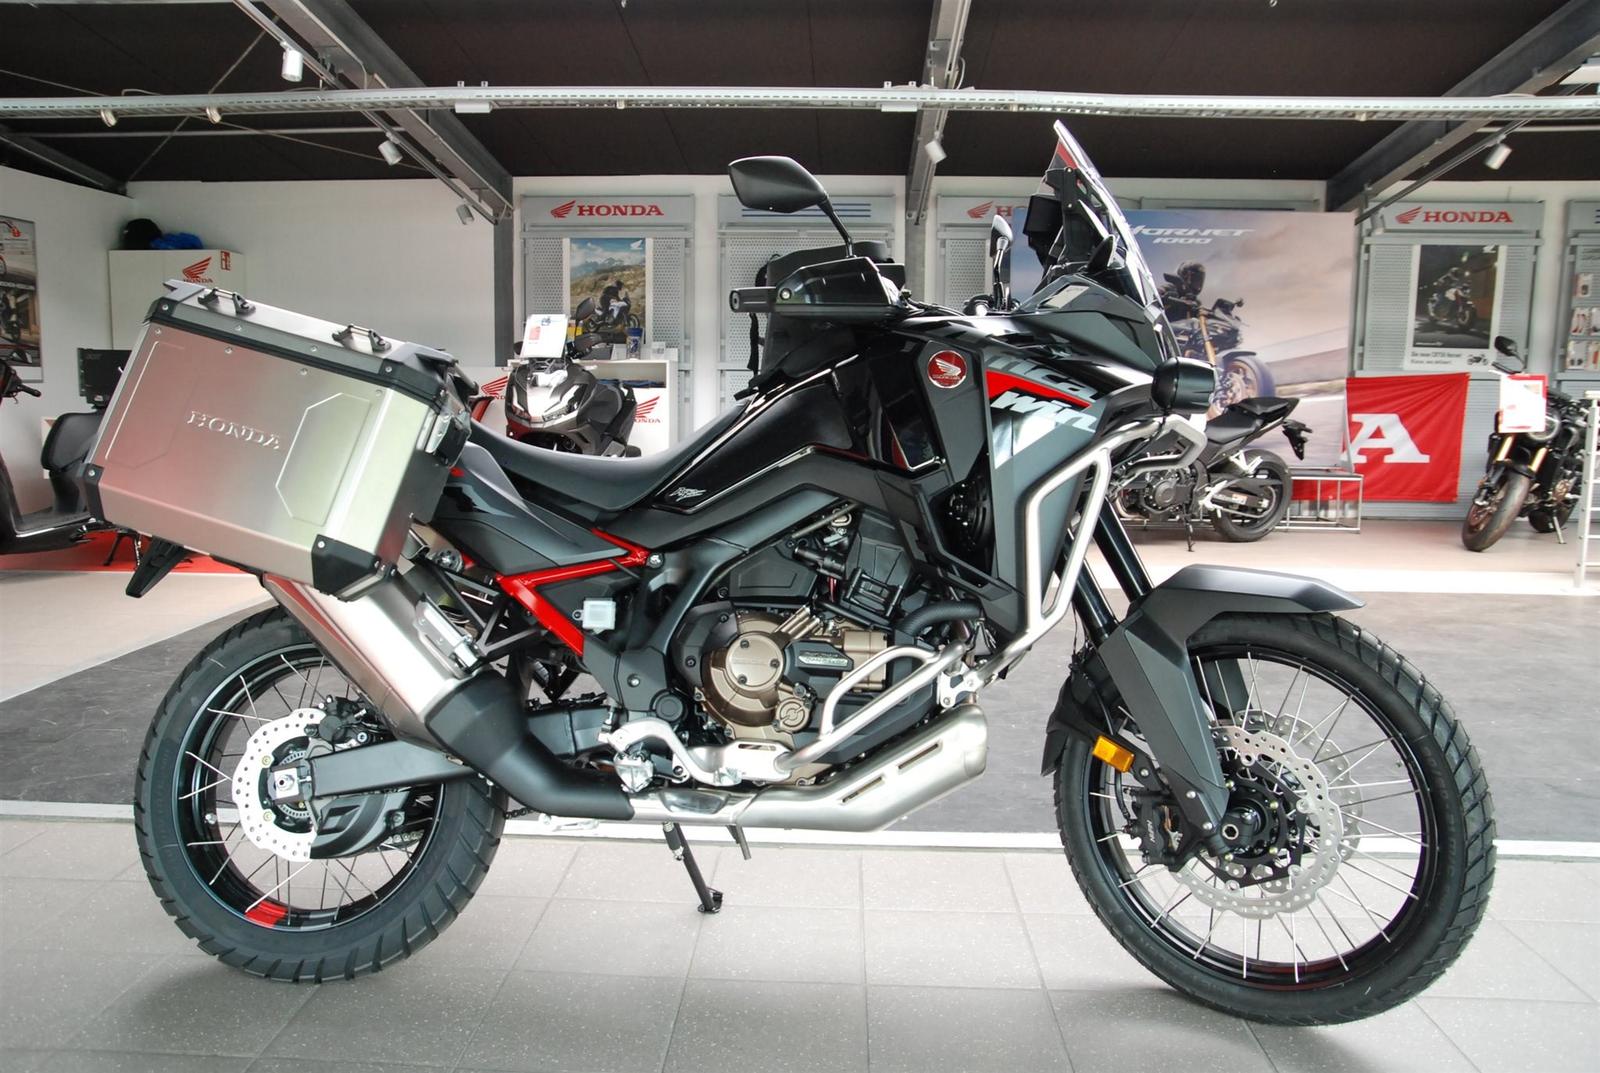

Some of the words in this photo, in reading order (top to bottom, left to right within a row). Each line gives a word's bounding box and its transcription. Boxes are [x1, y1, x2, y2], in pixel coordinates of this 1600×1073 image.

[577, 205, 664, 216] HONDA
[1423, 211, 1513, 223] HONDA
[1152, 237, 1213, 245] 1000
[187, 410, 280, 450] HONDA
